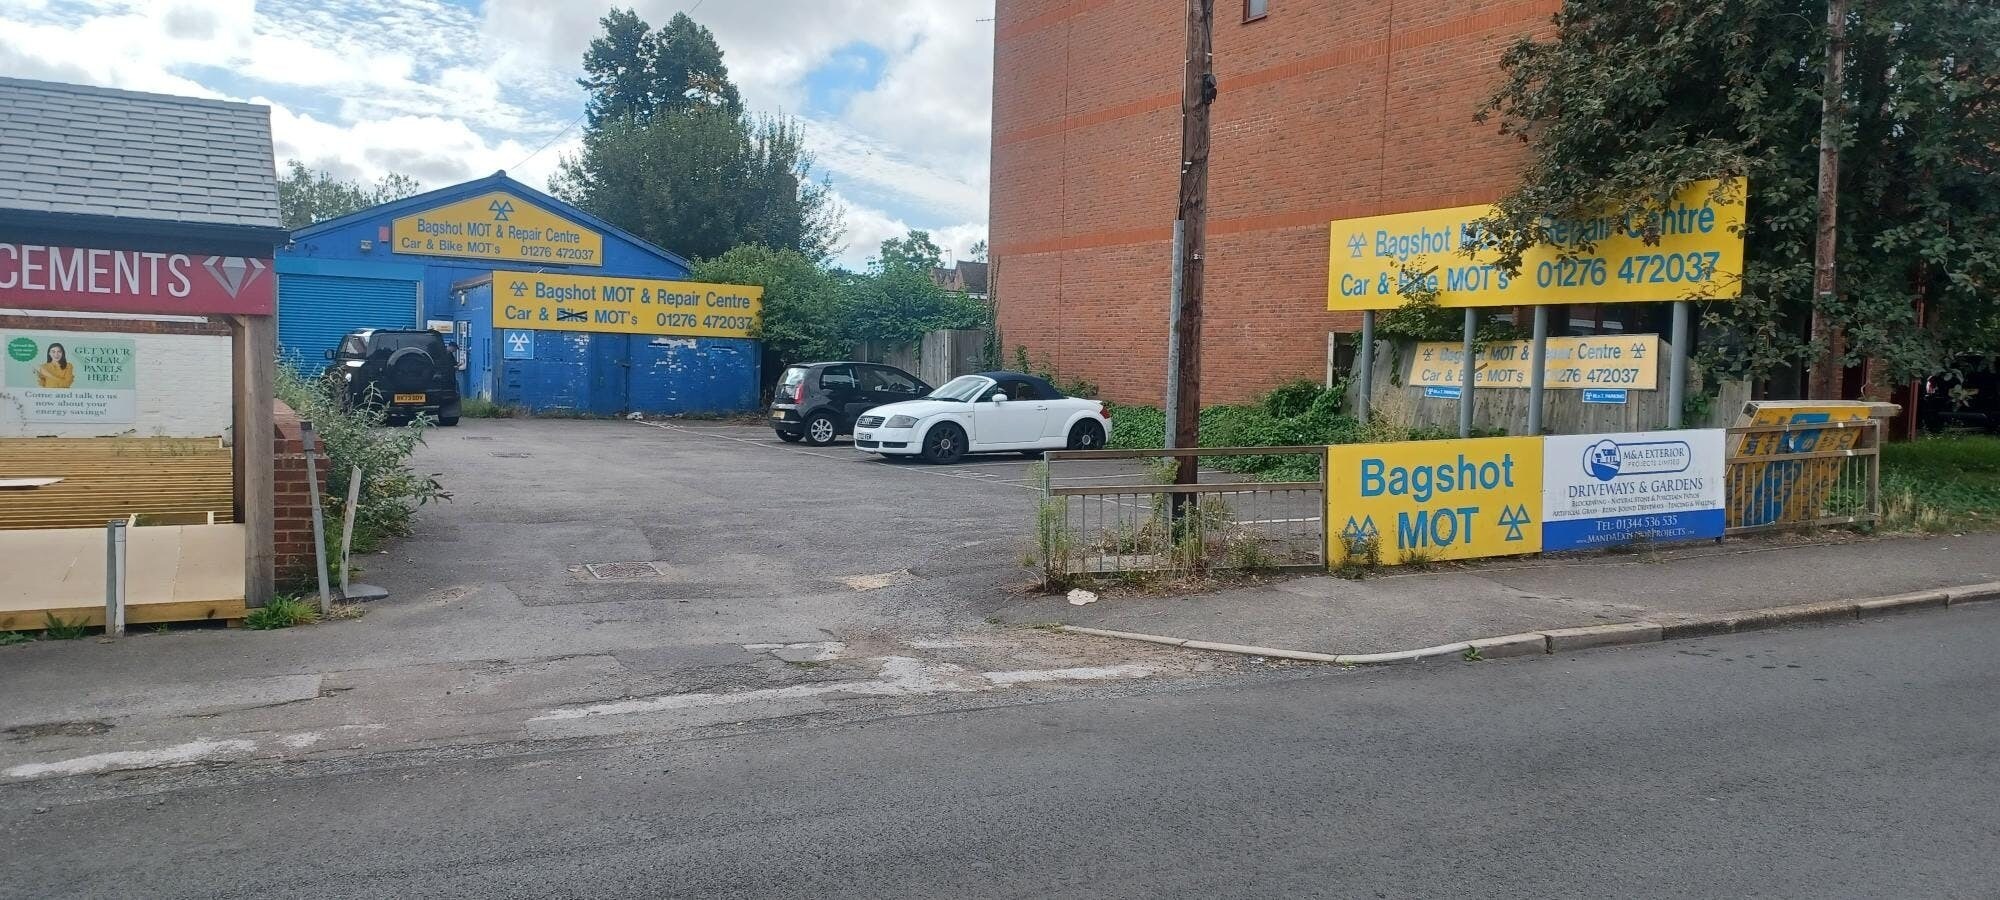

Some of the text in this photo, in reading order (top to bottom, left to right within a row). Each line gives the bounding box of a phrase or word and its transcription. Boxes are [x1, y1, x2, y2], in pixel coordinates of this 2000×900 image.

[418, 218, 580, 243] Bagshot MOT & Repair Centre
[402, 237, 594, 260] Car & Bike MOT's 01276 472037
[1376, 226, 1451, 262] Bagshot
[0, 242, 192, 298] CEMENTS
[1341, 273, 1370, 296] Car
[1377, 272, 1389, 294] &
[1536, 256, 1607, 288] 01276
[1618, 252, 1720, 283] 472037
[535, 282, 750, 309] Bagshot MOT & Repair Centre
[506, 306, 531, 320] Car
[539, 307, 548, 320] &
[595, 310, 638, 325] MOT's
[656, 312, 697, 327] 01276
[703, 315, 752, 329] 472037
[84, 356, 120, 364] SOLAR
[99, 348, 130, 356] YOUR
[1490, 346, 1518, 360] MOT
[1521, 345, 1529, 361] &
[1578, 343, 1621, 359] Centre
[84, 365, 122, 373] PANELS
[88, 374, 120, 382] HERE!
[1421, 369, 1442, 382] Car
[1445, 369, 1453, 382] &
[1587, 368, 1640, 383] 472037
[25, 391, 51, 399] Come
[70, 408, 107, 416] savings!
[86, 401, 107, 409] your
[1623, 447, 1685, 460] M&A EXTERIOR
[1361, 454, 1514, 503] Bagshot
[1568, 477, 1703, 498] DRIVEWAYS & GARDENS
[1397, 506, 1479, 549] MOT
[1595, 514, 1678, 531] TEL: 01344 536 535
